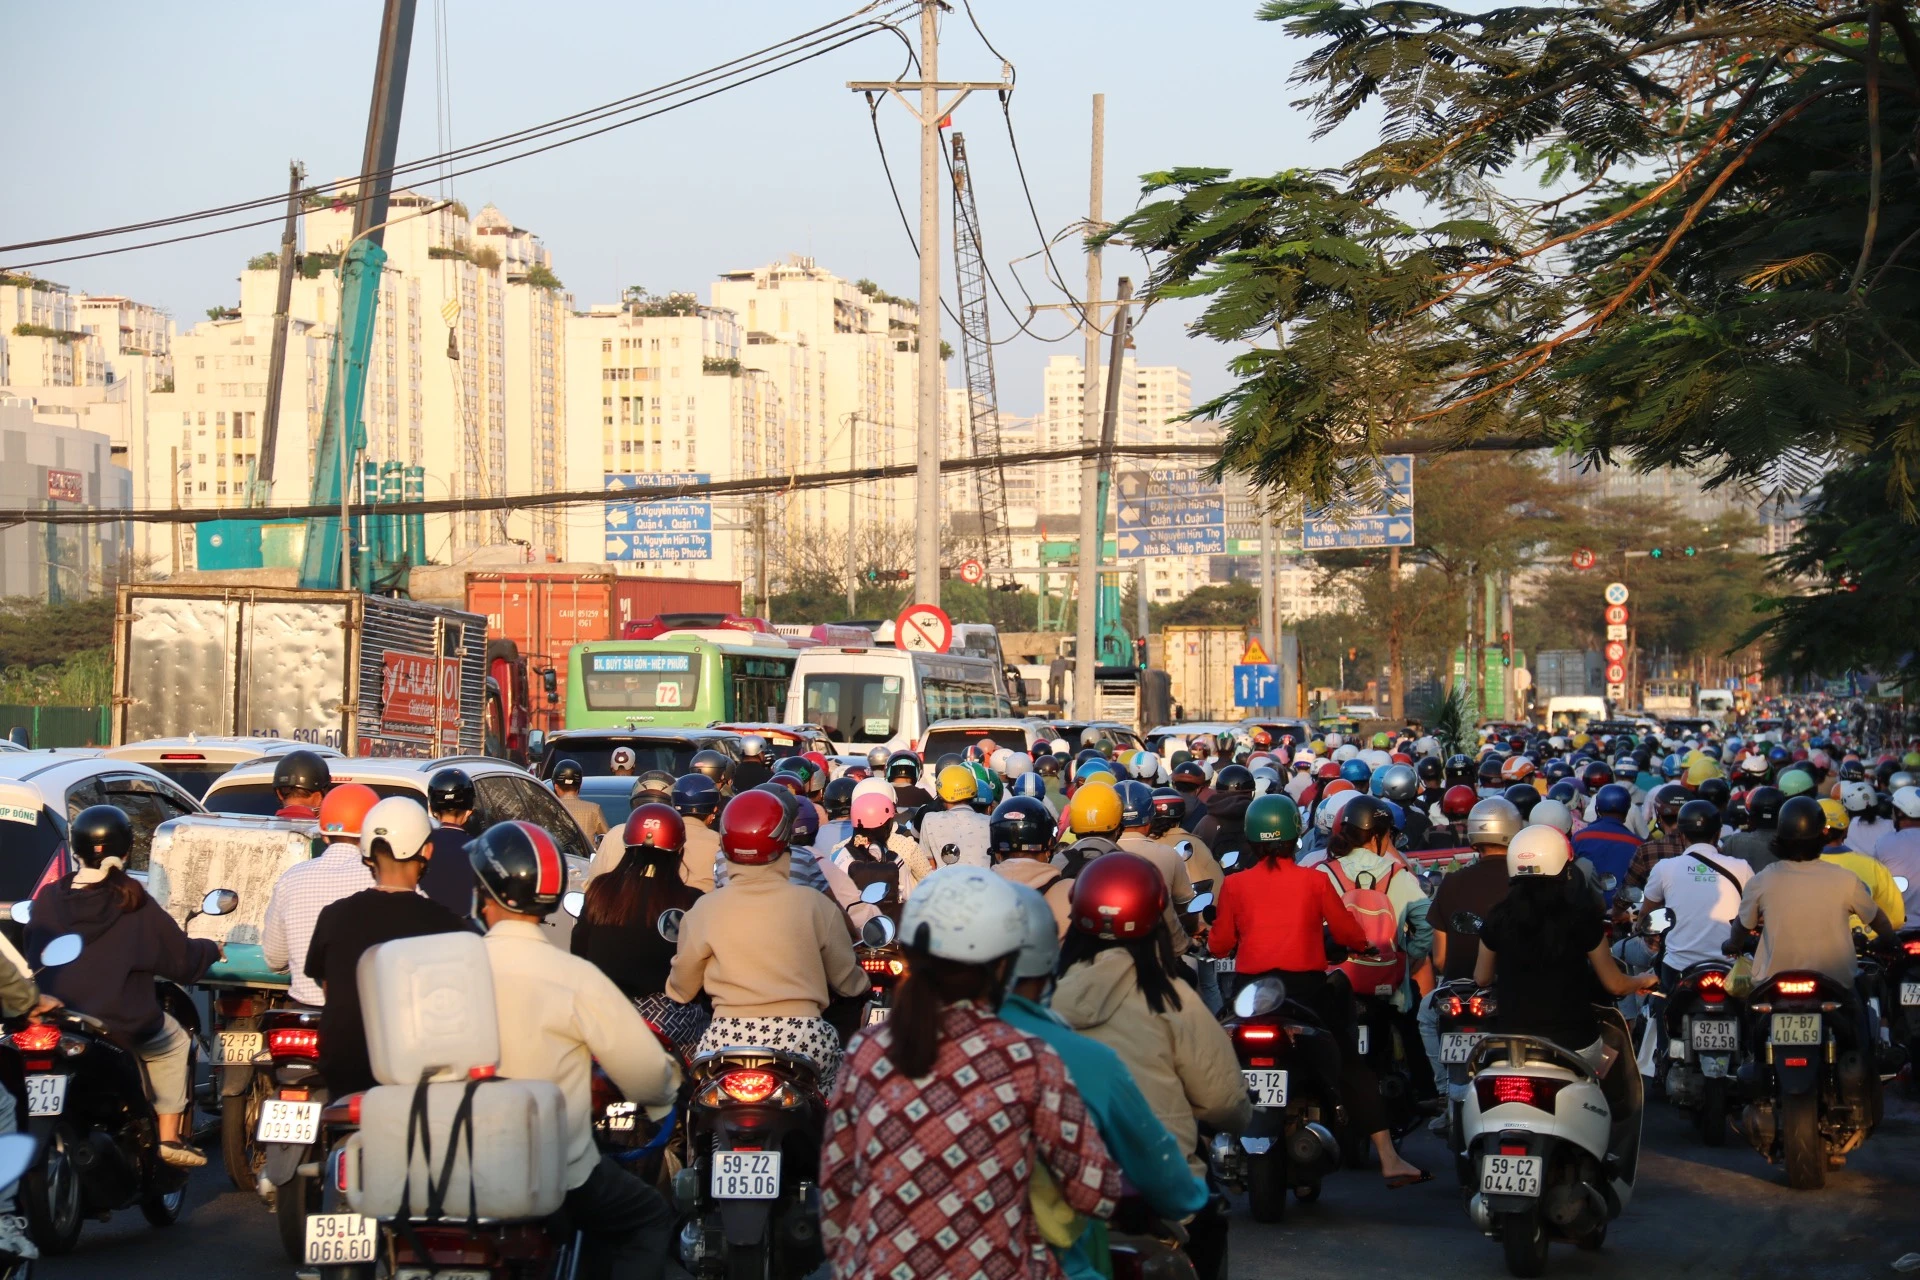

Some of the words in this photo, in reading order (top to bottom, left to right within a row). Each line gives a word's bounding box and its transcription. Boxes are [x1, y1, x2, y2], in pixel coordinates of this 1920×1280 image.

[690, 505, 705, 517] Thọ
[636, 519, 657, 530] Quận
[672, 518, 691, 530] Quận
[1151, 515, 1171, 527] Quận
[1184, 513, 1204, 525] Quận
[691, 535, 705, 547] Thọ
[682, 547, 708, 559] Phước
[606, 656, 622, 670] BUÝT
[667, 655, 688, 670] PHƯỚC
[659, 687, 677, 704] 72
[642, 818, 661, 829] 5G
[1780, 1016, 1814, 1029] 17-B7
[220, 1034, 257, 1047] 52-P3
[1774, 1030, 1818, 1042] 404.69
[217, 1048, 254, 1062] 4060
[723, 1155, 770, 1174] 59-Z2
[1491, 1158, 1533, 1176] 59-C2
[716, 1175, 775, 1195] 185.06
[1484, 1175, 1537, 1193] 044.03
[316, 1217, 366, 1238] 59-LA
[310, 1239, 371, 1262] 066.60
